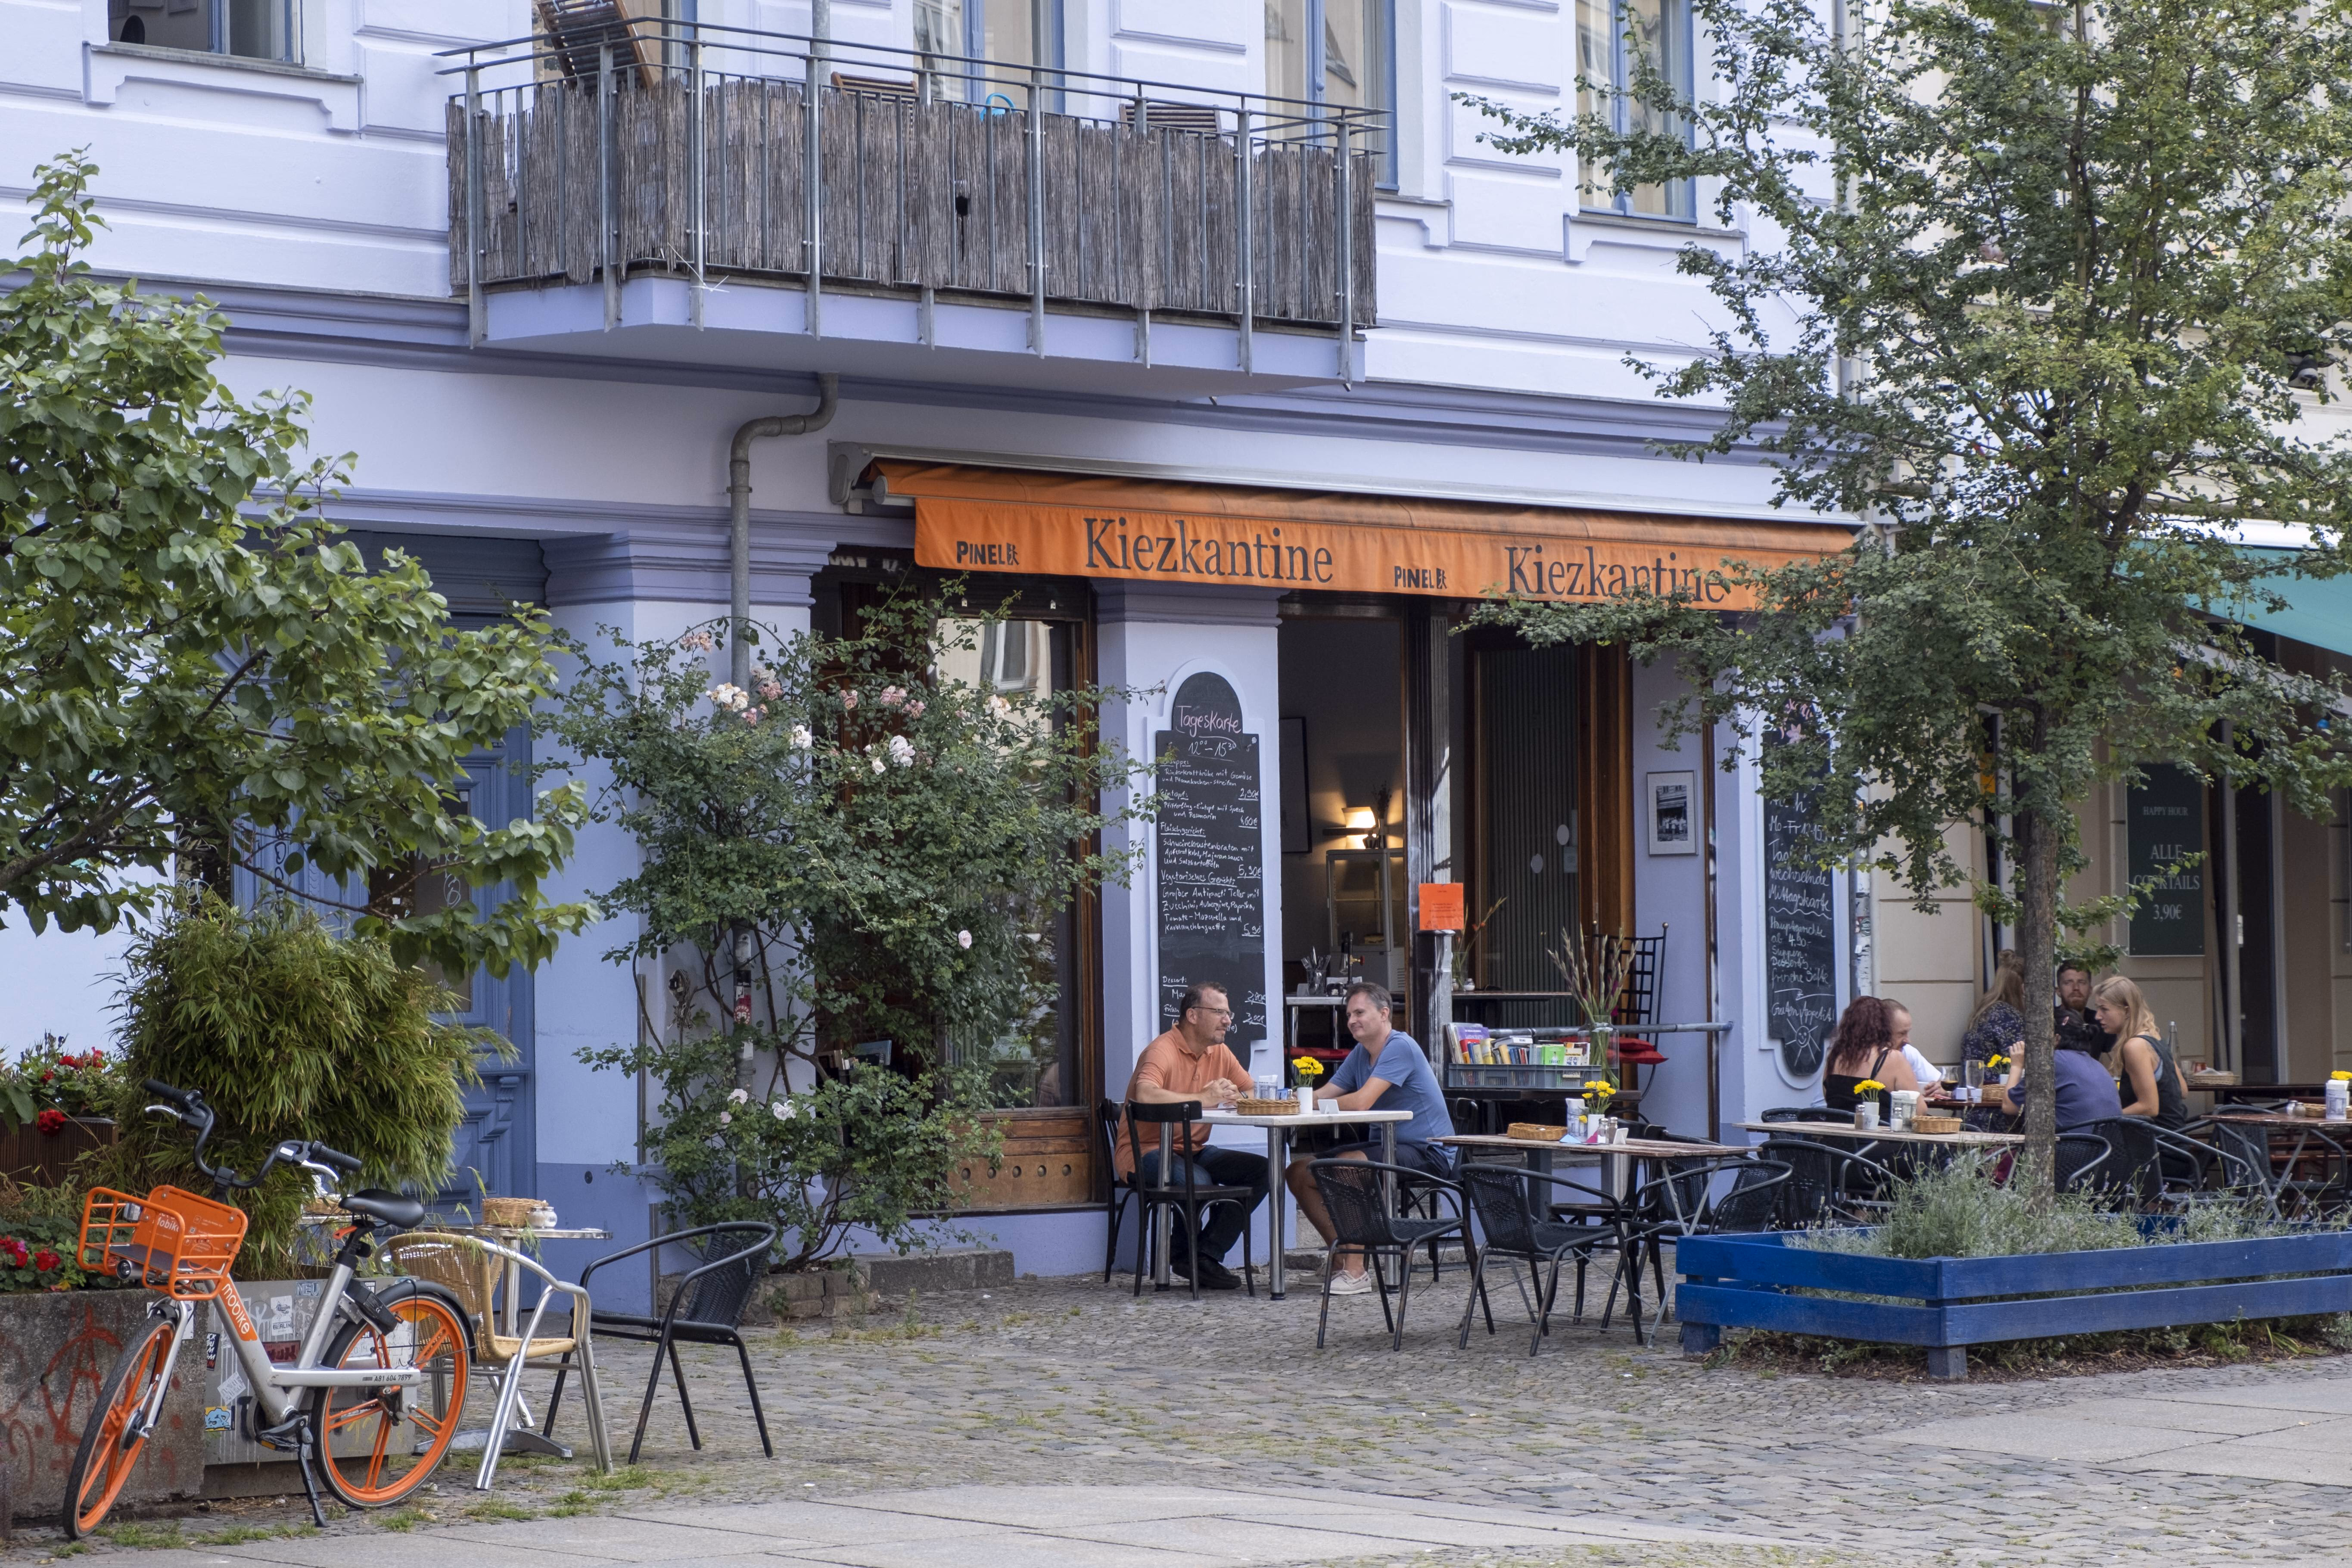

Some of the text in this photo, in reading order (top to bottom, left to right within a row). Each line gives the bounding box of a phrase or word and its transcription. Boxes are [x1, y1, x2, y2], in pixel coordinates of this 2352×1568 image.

[1083, 516, 1333, 583] Kiezkantine
[1504, 544, 1724, 603] Kiezkantine
[2143, 806, 2188, 816] HAPPY HOUR
[2150, 844, 2183, 859] ALLE
[1247, 889, 1260, 899] mit
[2153, 904, 2183, 922] 3,90€
[1771, 933, 1783, 943] ab
[297, 1283, 319, 1296] NEU
[222, 1283, 251, 1334] mobike
